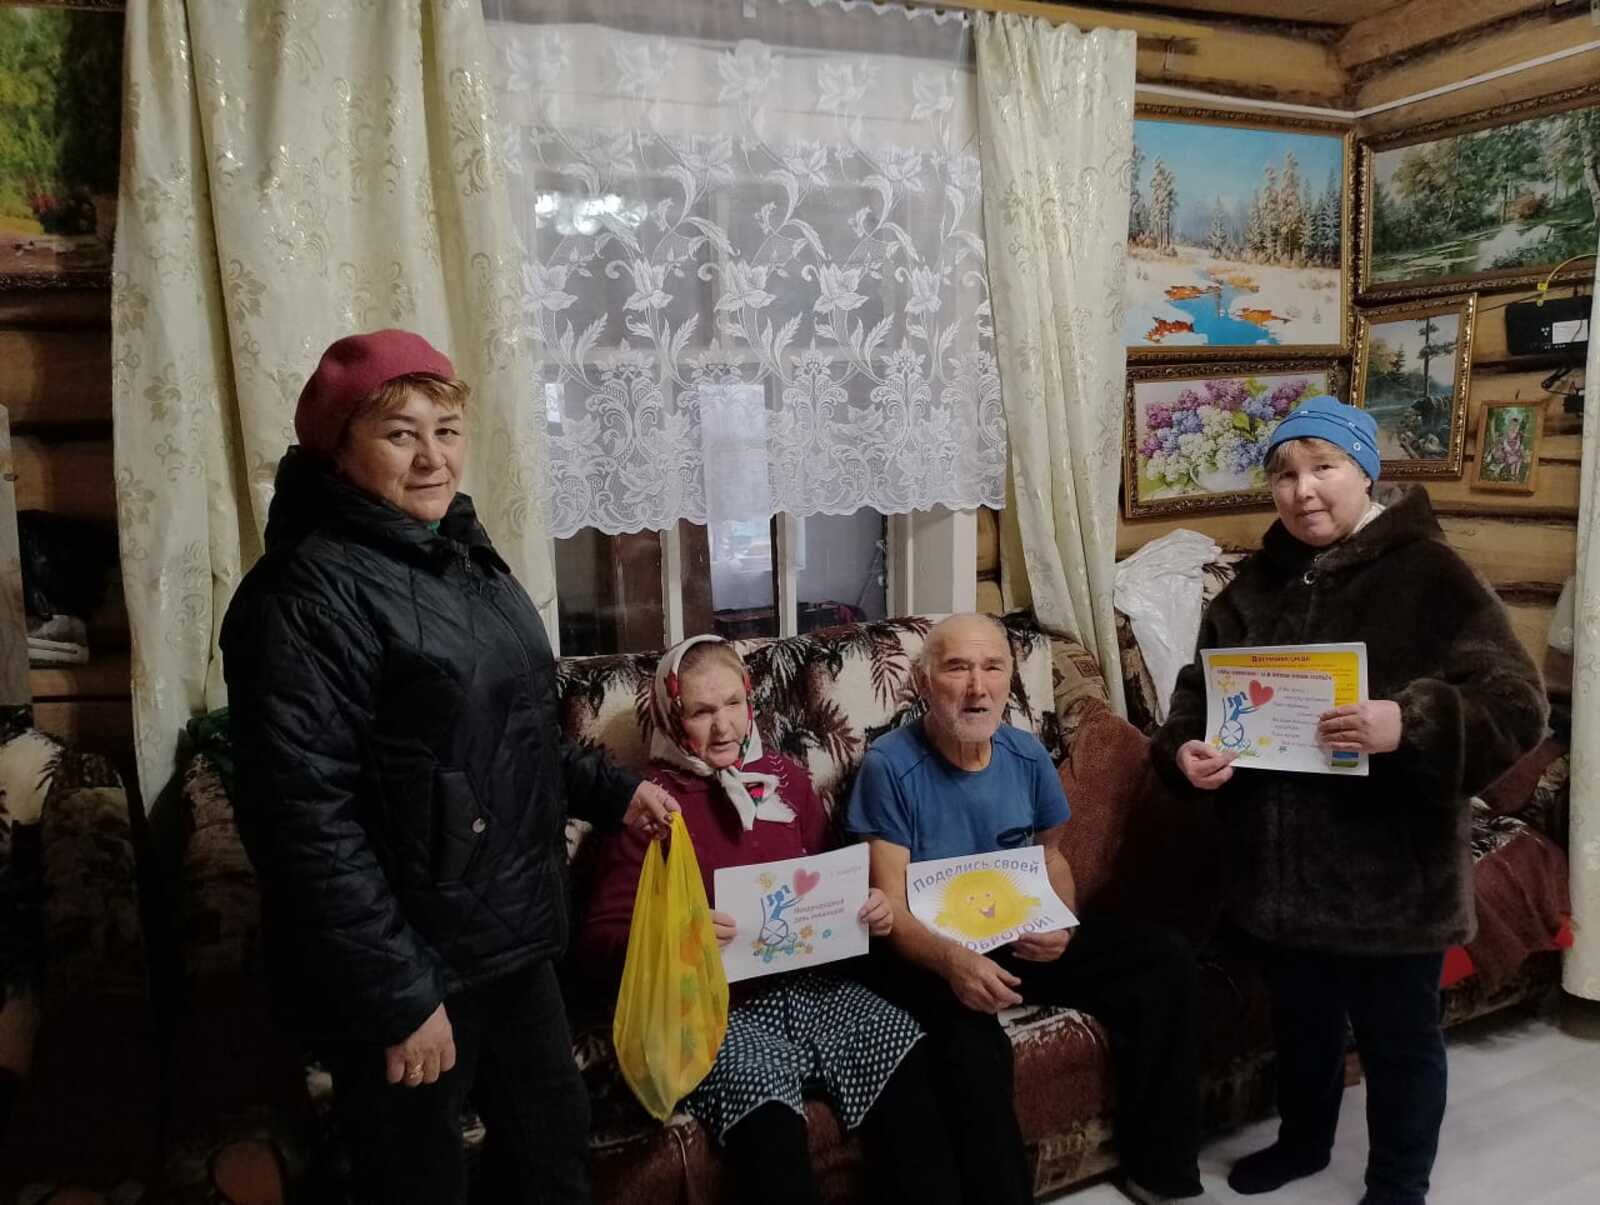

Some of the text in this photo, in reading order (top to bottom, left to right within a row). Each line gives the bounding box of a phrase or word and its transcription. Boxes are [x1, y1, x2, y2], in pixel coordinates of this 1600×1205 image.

[912, 859, 1040, 893] Поделись своей
[960, 914, 1057, 950] ОБРОТОЙ!
